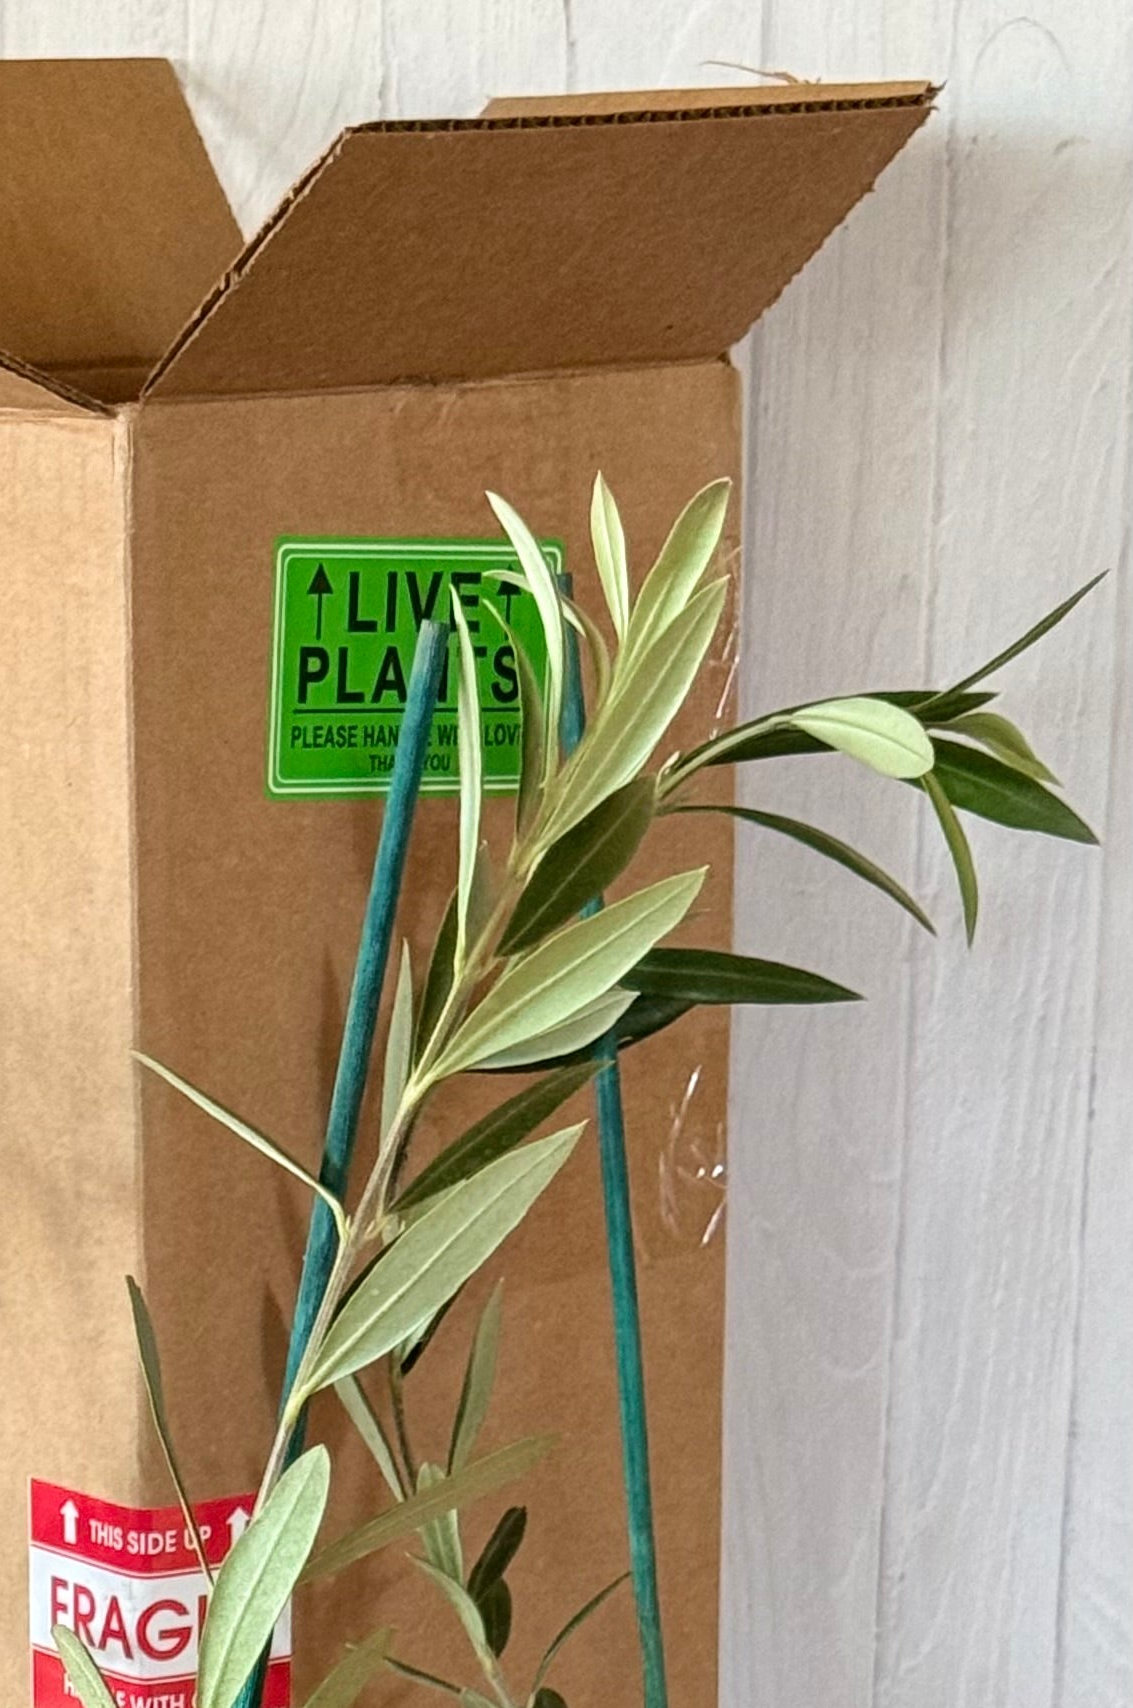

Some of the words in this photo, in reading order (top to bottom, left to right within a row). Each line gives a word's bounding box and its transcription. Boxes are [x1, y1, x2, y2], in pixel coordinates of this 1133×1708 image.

[347, 571, 483, 633] LIVE
[297, 646, 519, 704] PLAS
[290, 724, 358, 749] PLEASE
[484, 723, 521, 746] LOV
[89, 1519, 124, 1551] THIS
[127, 1529, 177, 1555] SIDE
[183, 1525, 212, 1551] UP
[50, 1575, 208, 1662] FRAGI
